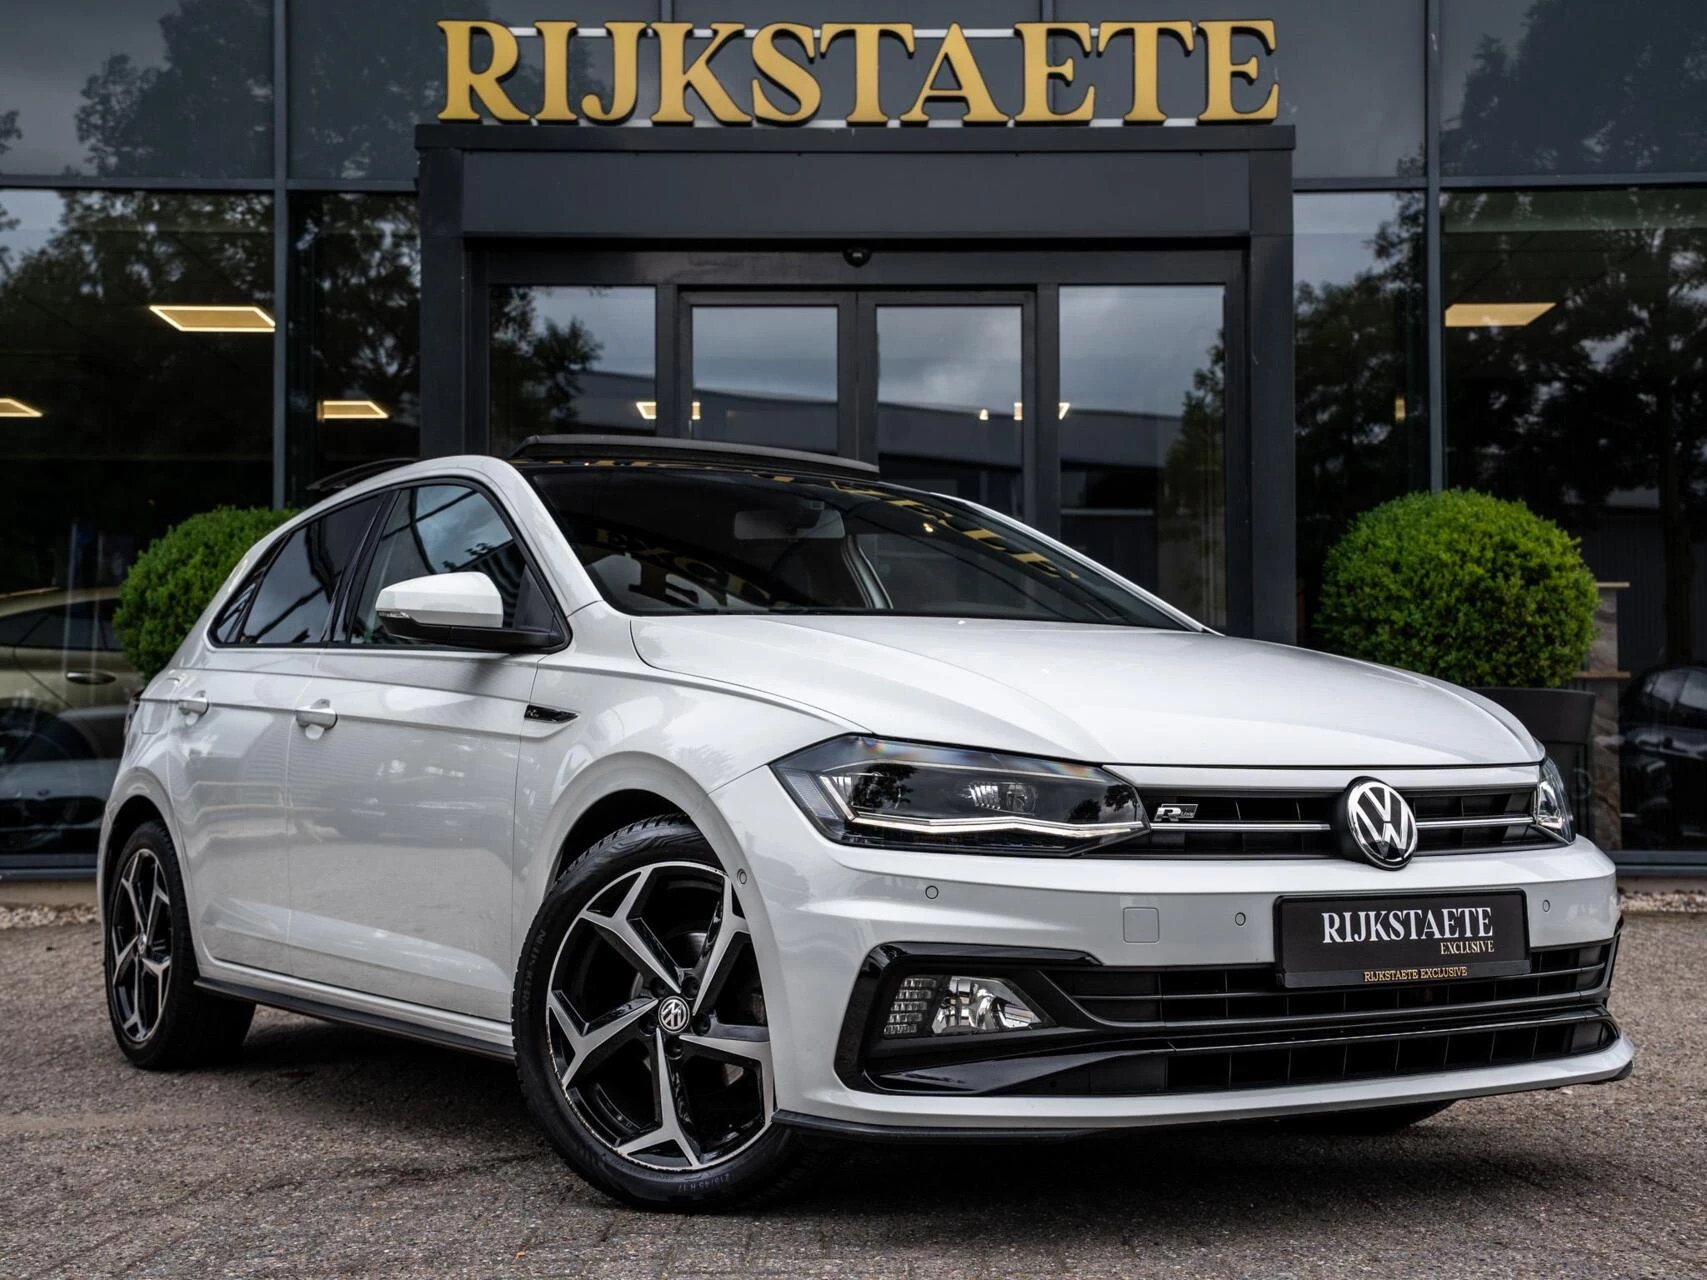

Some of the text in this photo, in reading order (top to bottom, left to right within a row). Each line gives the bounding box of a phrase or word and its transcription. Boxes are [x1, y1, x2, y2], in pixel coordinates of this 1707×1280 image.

[436, 20, 1279, 126] RIJKSTAETE
[1321, 907, 1493, 943] RIJKSTAETE
[1440, 940, 1495, 955] EXCLUSIVE
[1364, 966, 1468, 982] RIJKSTAETE EXCLUSIVE
